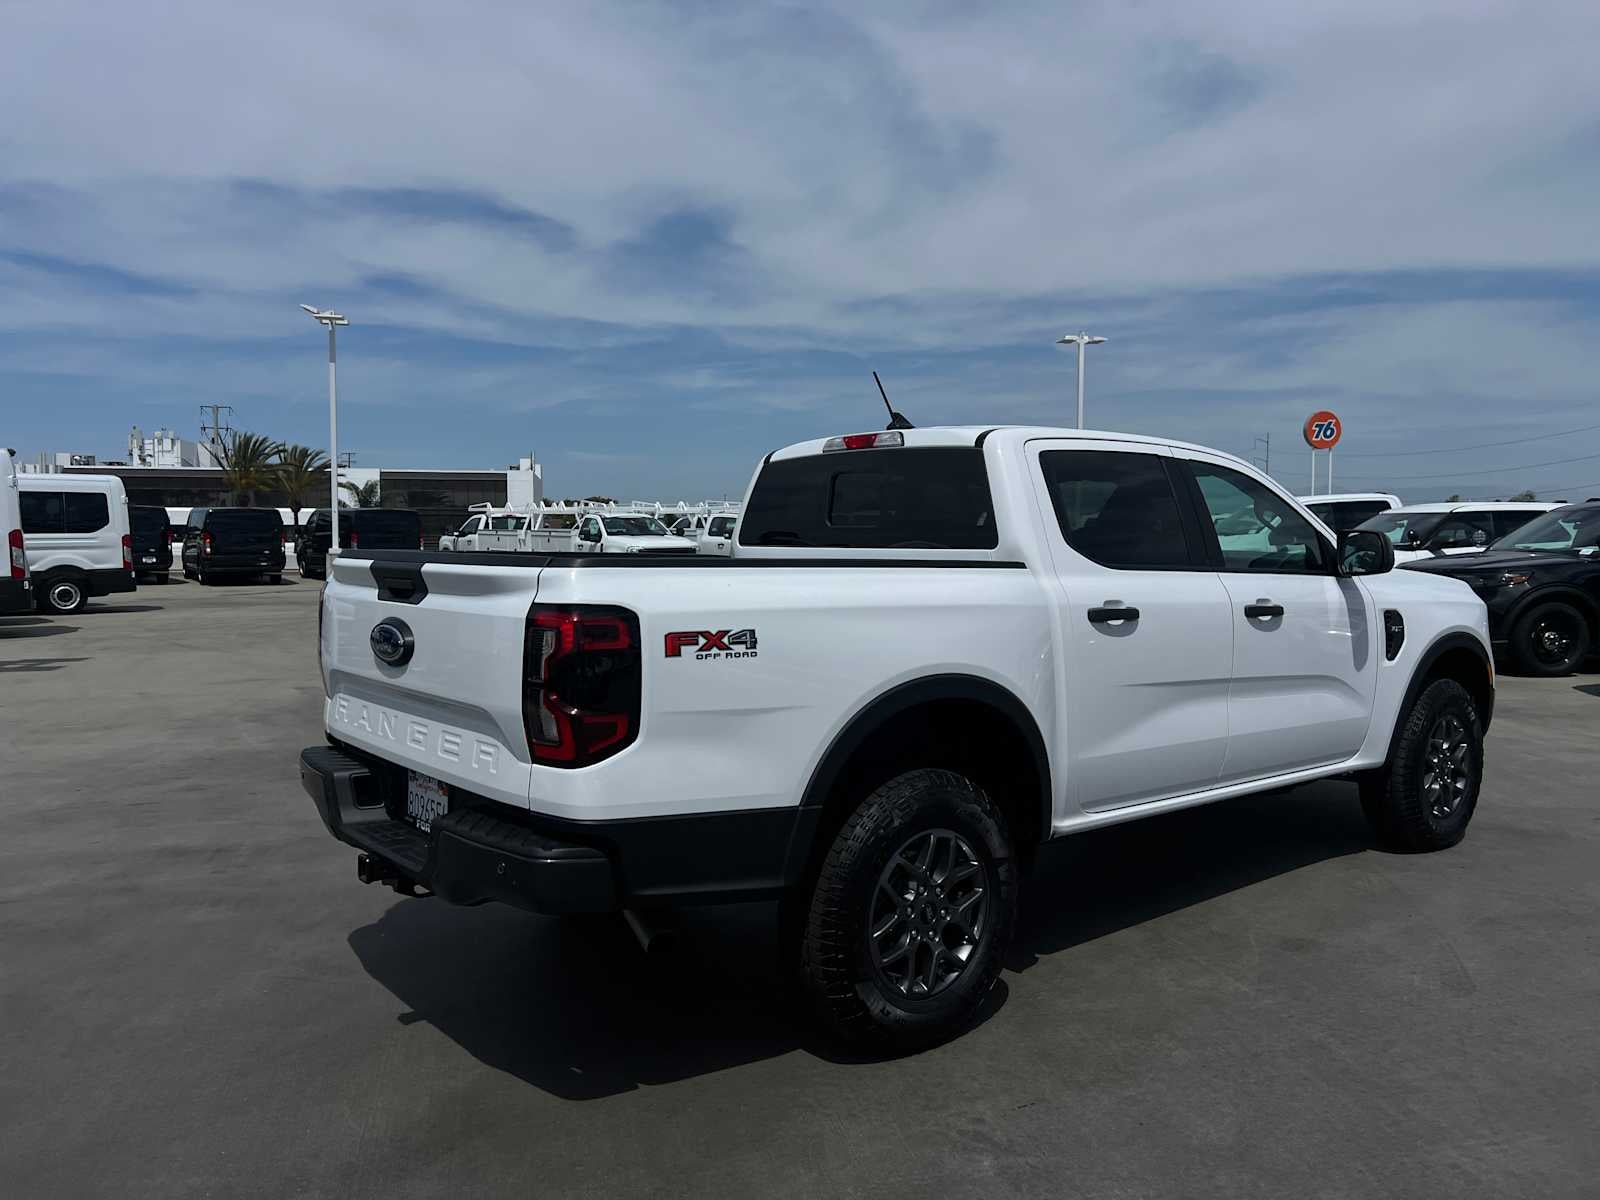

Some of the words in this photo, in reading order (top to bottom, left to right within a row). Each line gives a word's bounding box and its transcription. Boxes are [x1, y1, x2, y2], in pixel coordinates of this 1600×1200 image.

[1312, 419, 1337, 441] 76
[664, 629, 758, 658] FX4
[725, 651, 758, 659] ROAD
[334, 693, 500, 774] RANGER
